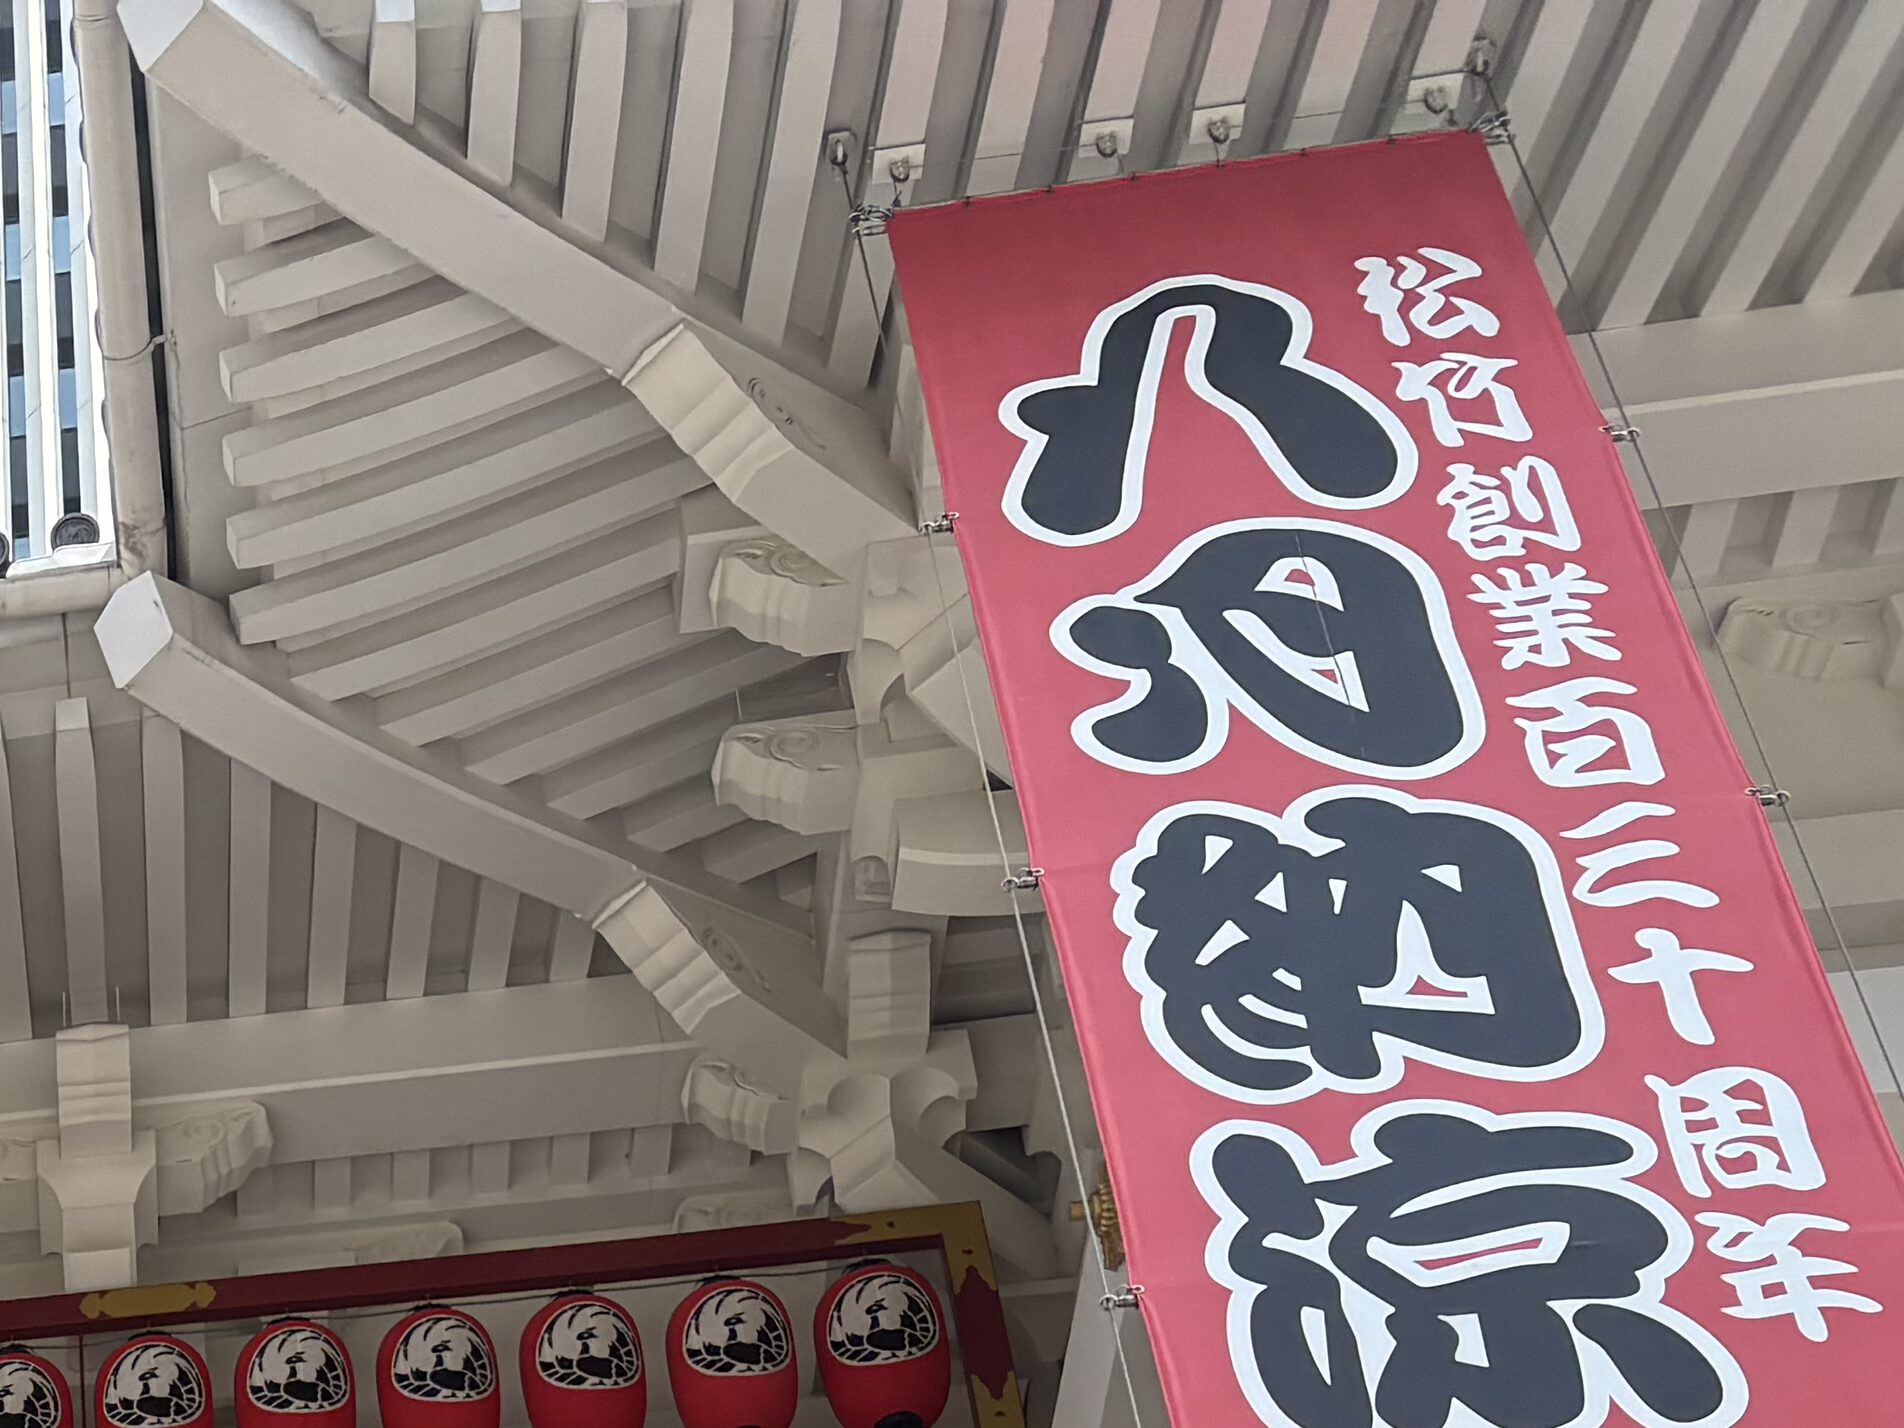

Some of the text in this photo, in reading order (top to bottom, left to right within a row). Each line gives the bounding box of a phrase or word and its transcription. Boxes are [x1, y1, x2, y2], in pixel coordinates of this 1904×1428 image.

[1354, 246, 1884, 1343] 松竹創業百三十周年
